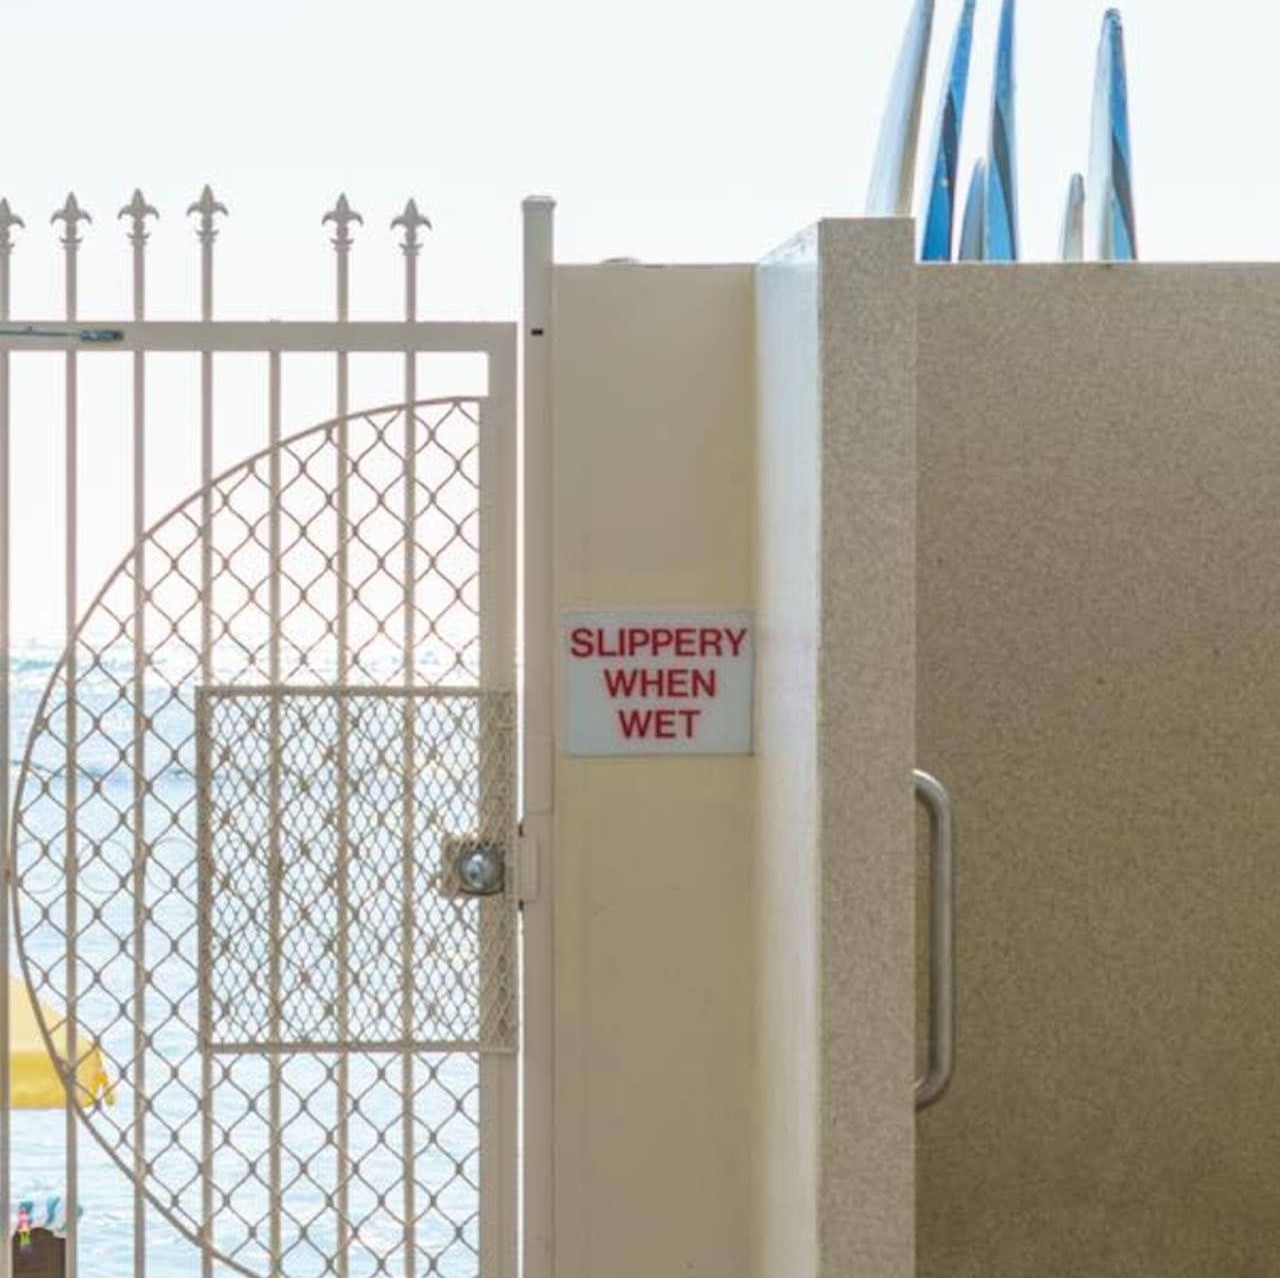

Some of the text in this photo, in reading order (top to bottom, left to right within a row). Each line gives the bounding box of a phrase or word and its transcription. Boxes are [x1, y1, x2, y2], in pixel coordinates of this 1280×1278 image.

[570, 628, 747, 658] SLIPPERY
[603, 668, 716, 698] WHEN
[618, 709, 701, 739] WET
